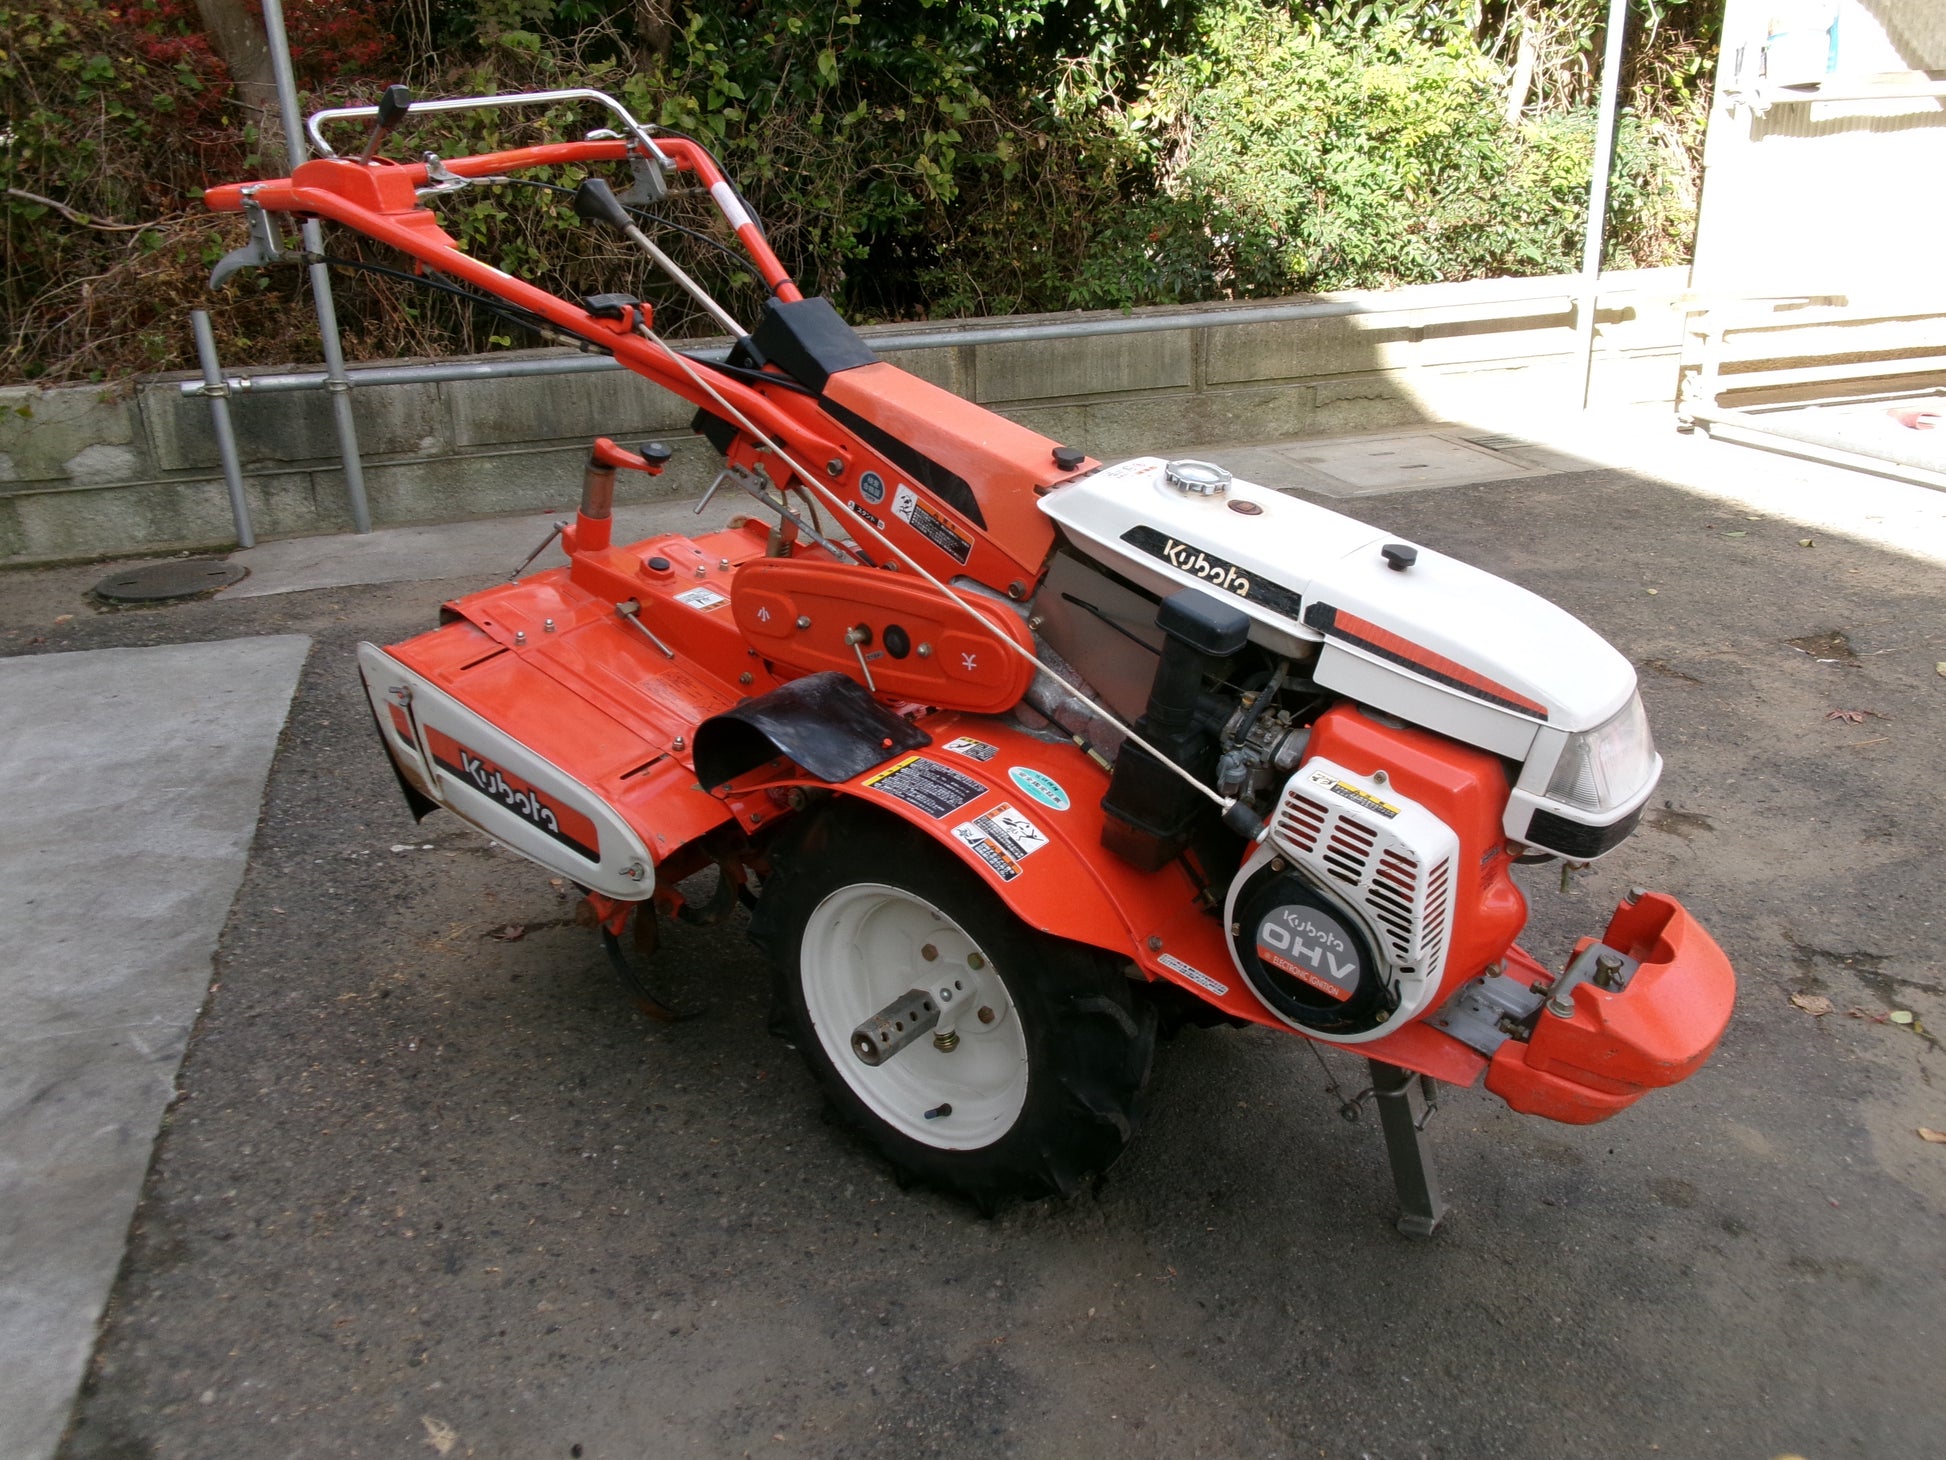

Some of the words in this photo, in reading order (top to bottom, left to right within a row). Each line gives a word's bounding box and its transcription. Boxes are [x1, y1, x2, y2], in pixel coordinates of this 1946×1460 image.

[1163, 539, 1250, 596] Kubota
[461, 751, 559, 833] Kubota
[1262, 922, 1356, 979] OHV
[1283, 910, 1345, 952] Kubota
[1272, 955, 1310, 981] ELECTRONIC
[1309, 975, 1340, 996] IGNITION
